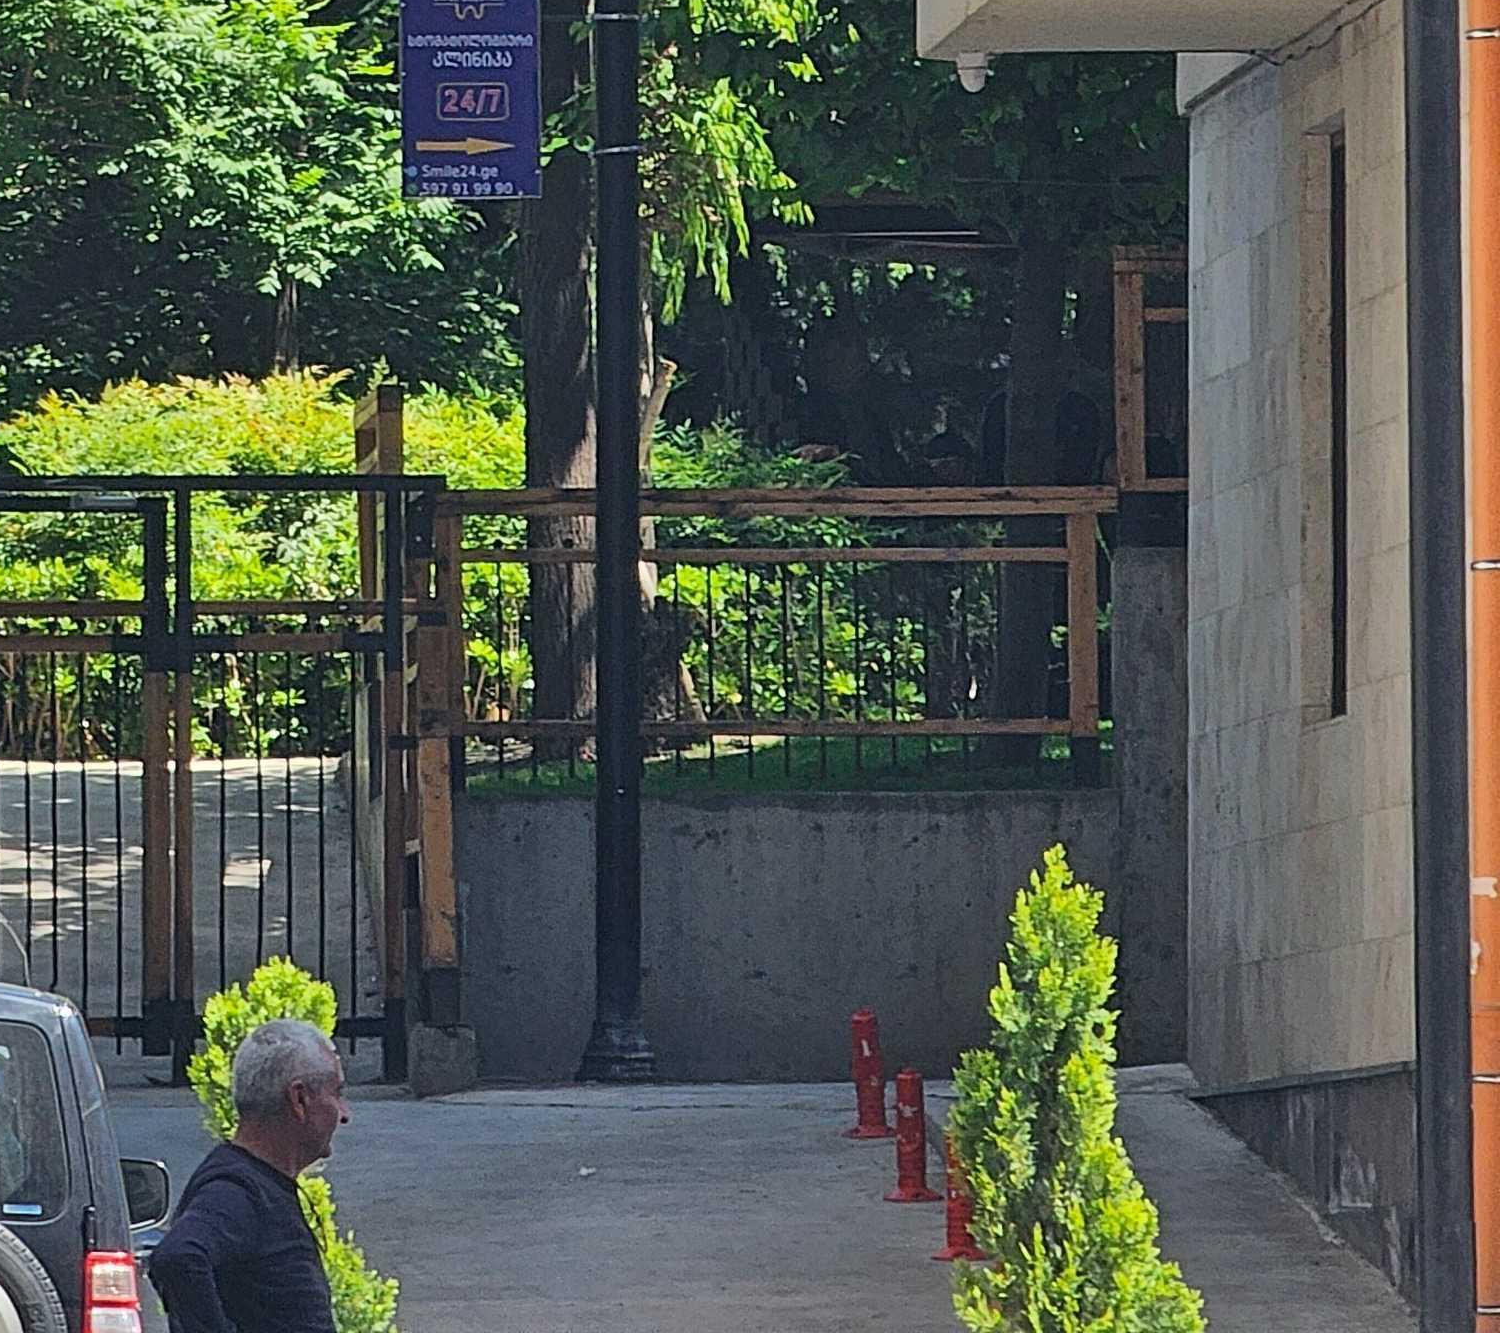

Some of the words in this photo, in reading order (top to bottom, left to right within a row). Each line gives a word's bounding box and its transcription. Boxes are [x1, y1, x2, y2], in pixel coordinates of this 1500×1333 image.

[432, 50, 513, 68] კლინიკა
[443, 89, 501, 116] 24/7
[421, 164, 498, 181] Smile24.ge
